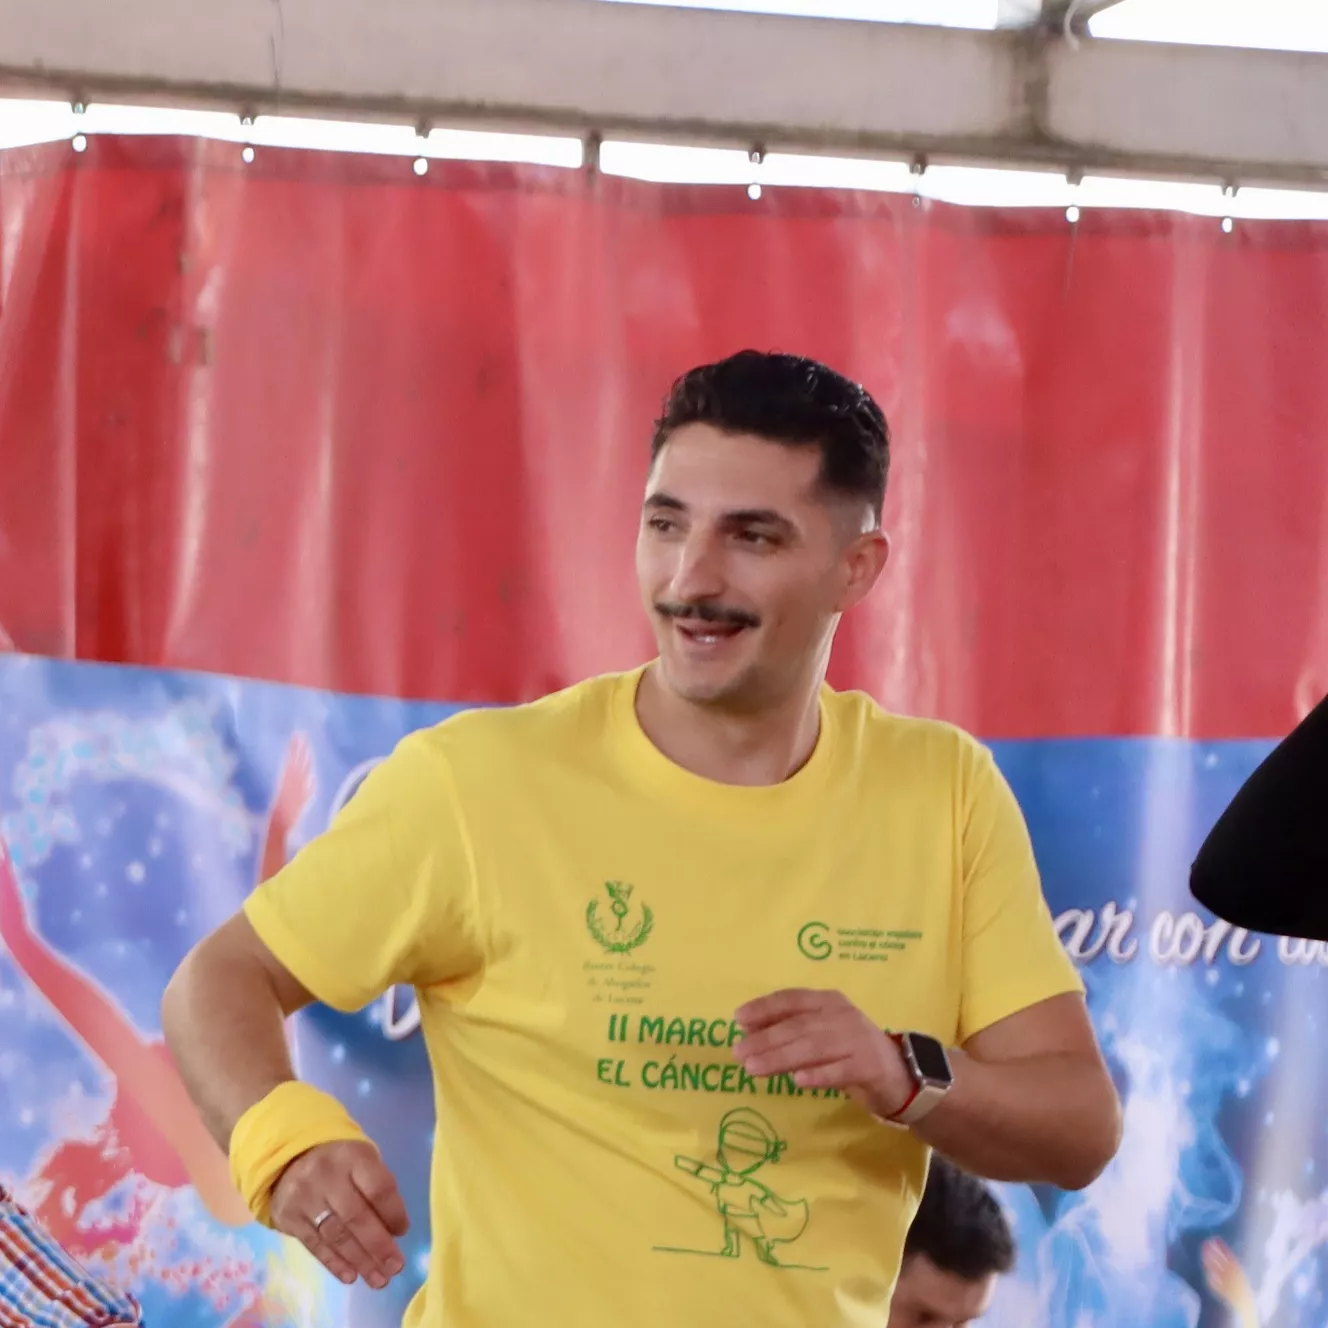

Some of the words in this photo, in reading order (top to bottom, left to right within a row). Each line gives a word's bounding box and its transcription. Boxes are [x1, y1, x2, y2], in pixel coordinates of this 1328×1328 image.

[608, 1013, 628, 1043] II
[597, 1058, 631, 1088] EL
[641, 1053, 756, 1094] CÁNCER
